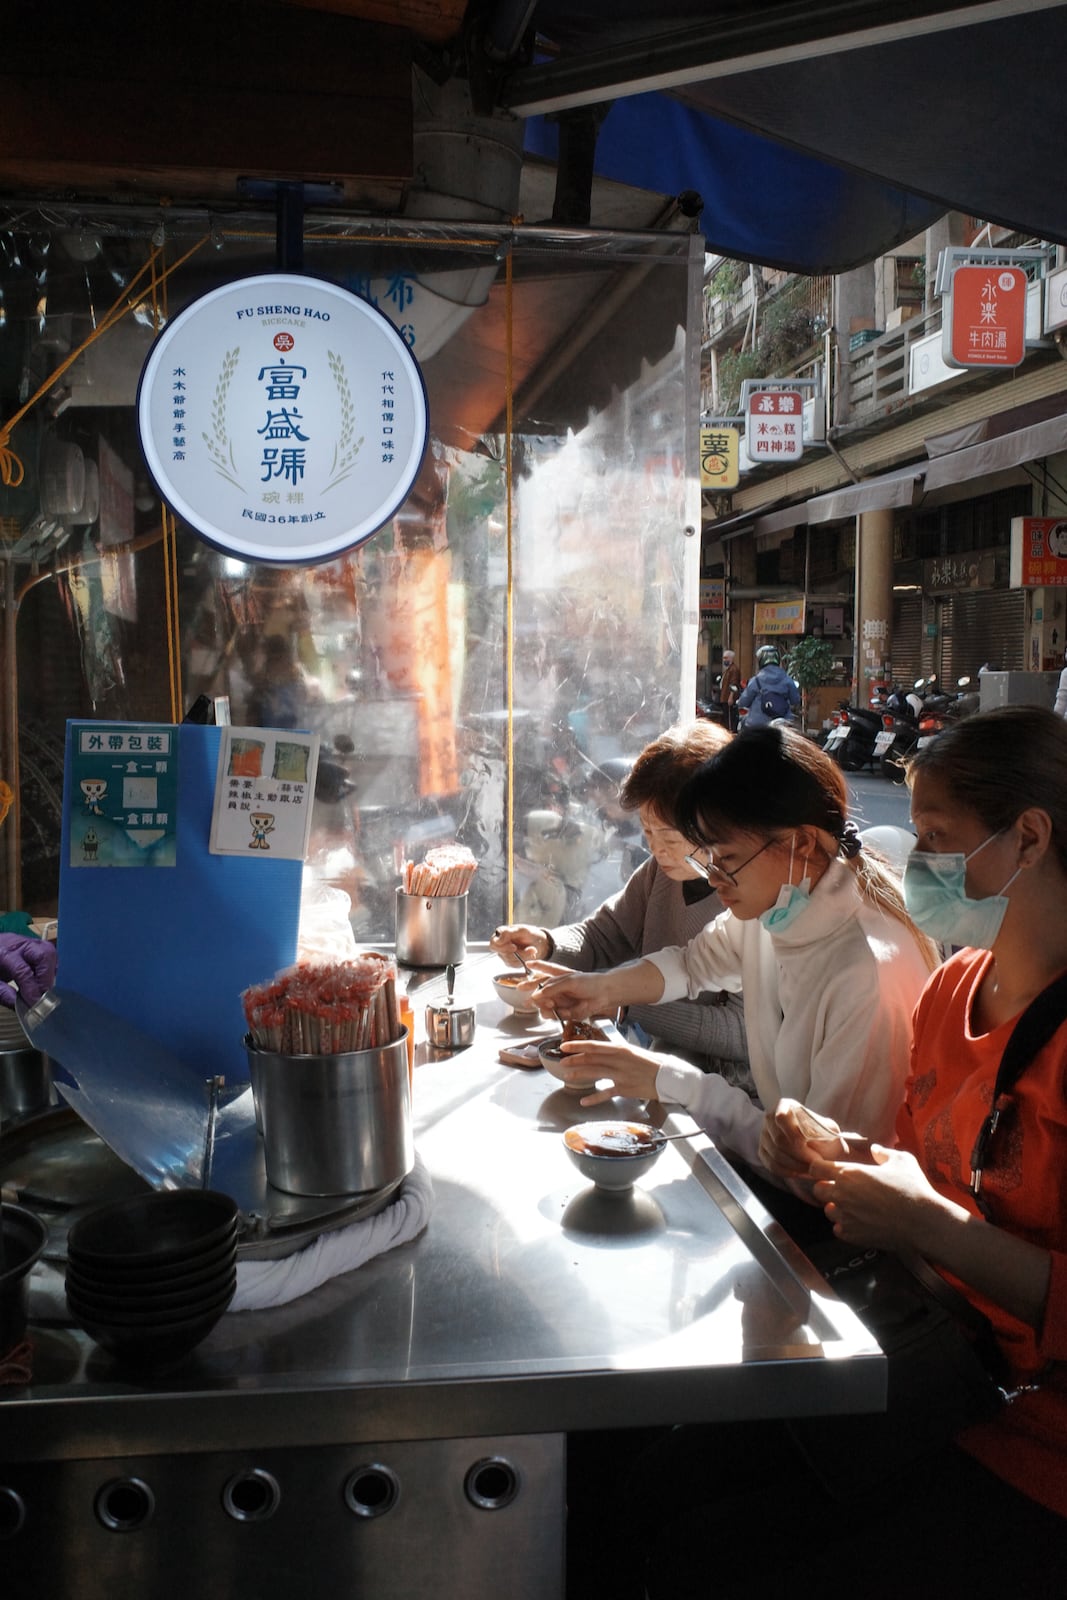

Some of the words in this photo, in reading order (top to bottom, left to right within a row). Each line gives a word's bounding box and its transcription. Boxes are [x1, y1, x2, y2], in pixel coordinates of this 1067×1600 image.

[236, 308, 254, 320] FU
[257, 305, 301, 316] SHENG
[304, 307, 330, 322] HAO
[261, 318, 306, 328] RICECAKE
[969, 331, 1007, 348] 牛肉湯
[758, 396, 795, 413] 永樂
[172, 367, 186, 461] 水木爺爺手藝高
[257, 358, 310, 486] 富盛號
[381, 371, 395, 463] 代代相傳口味好
[757, 440, 797, 453] 四神湯
[262, 491, 305, 505] 碗粿
[241, 508, 326, 524] 民國36年創立
[89, 735, 163, 751] 外帶包裝
[112, 760, 167, 773] 一盒一顆
[113, 813, 168, 825] 一盒兩顆
